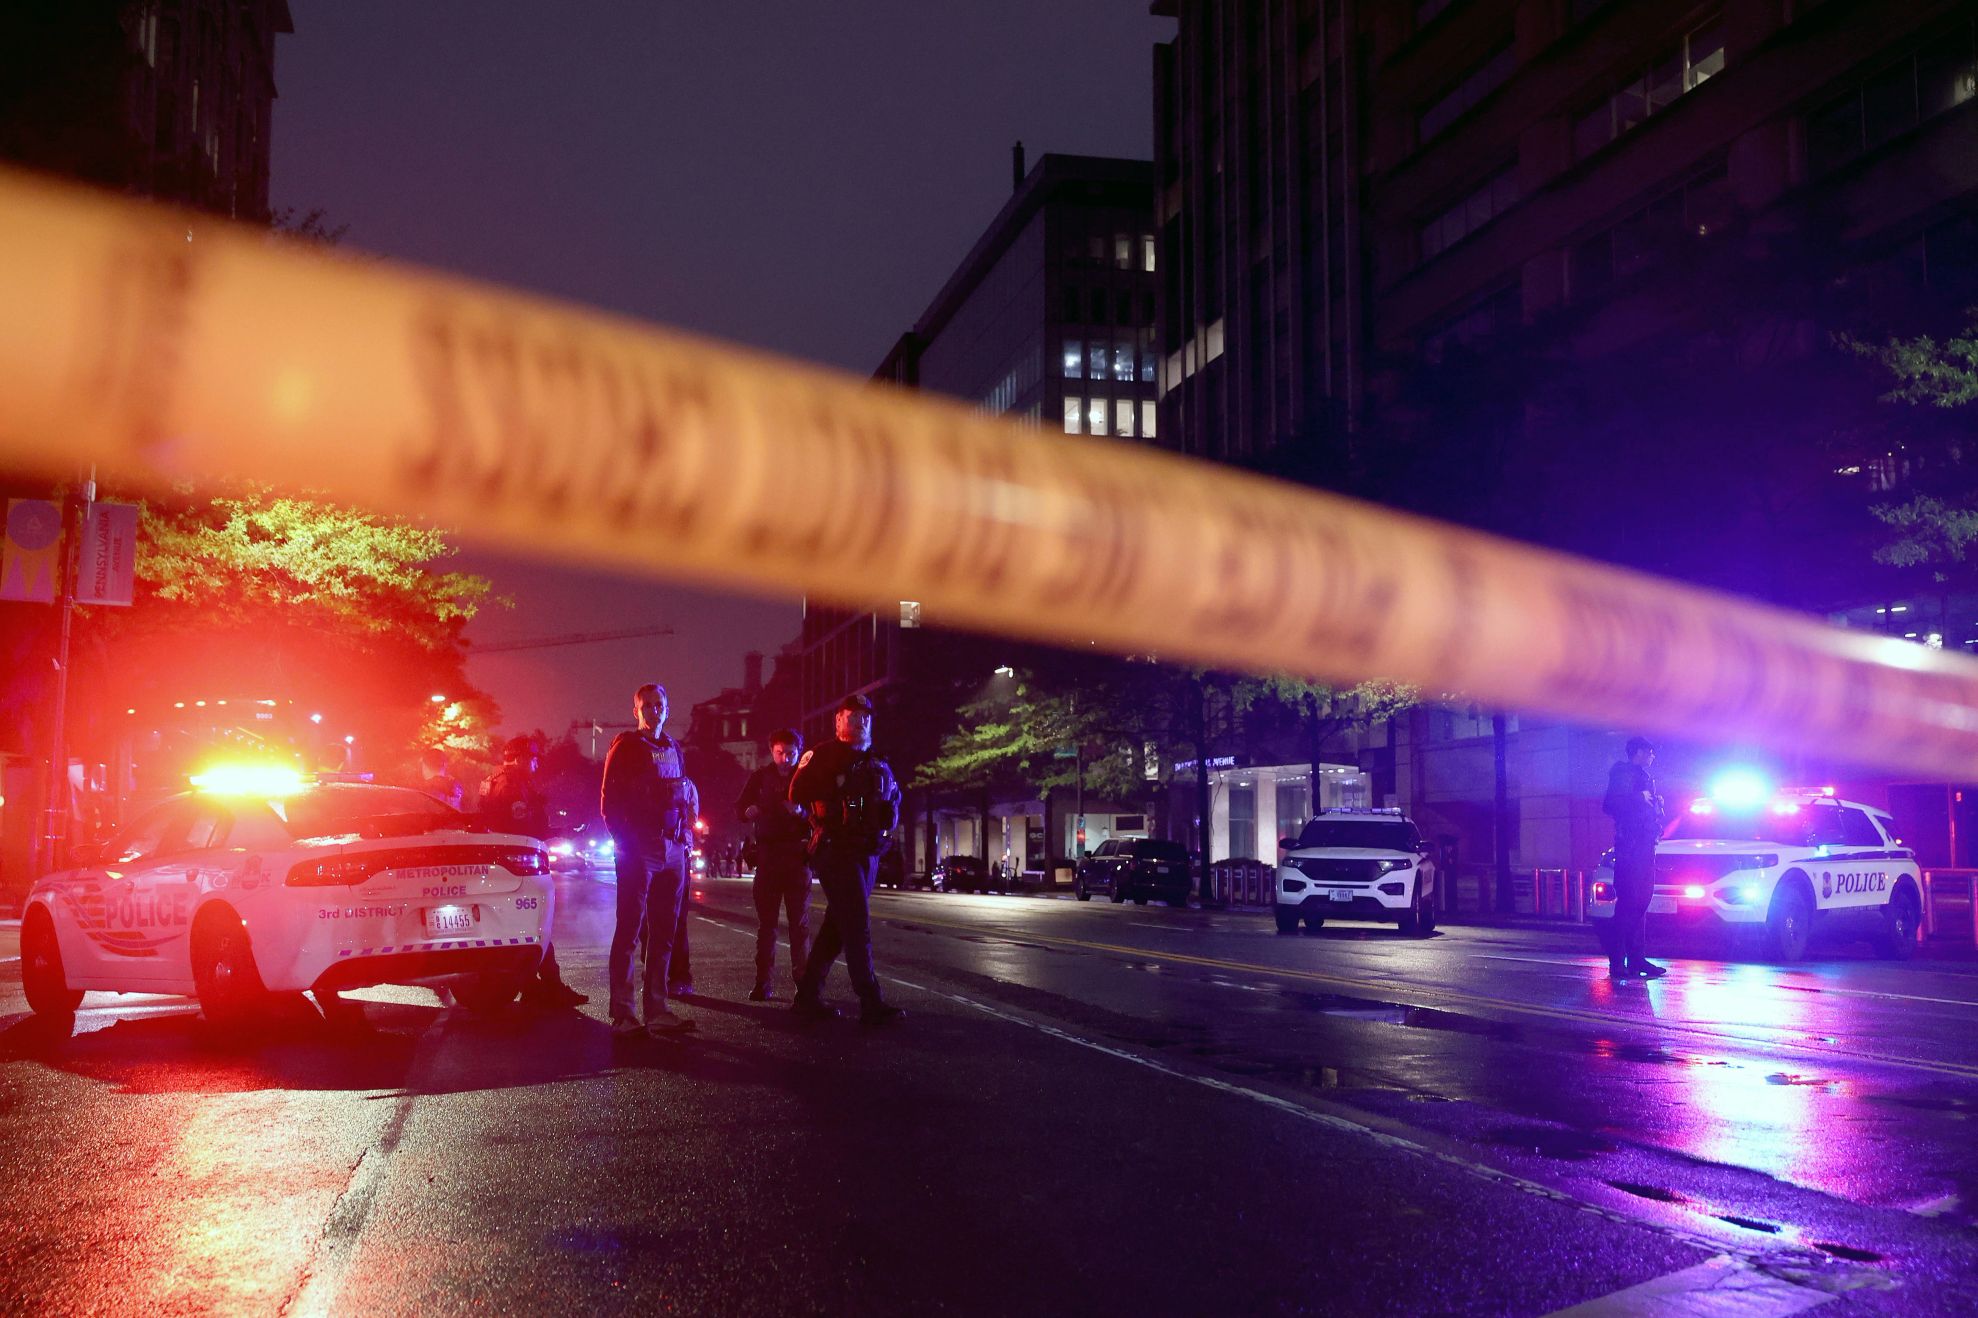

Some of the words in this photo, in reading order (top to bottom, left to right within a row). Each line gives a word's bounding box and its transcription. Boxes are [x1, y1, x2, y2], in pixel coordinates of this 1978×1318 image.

[94, 511, 110, 598] PENNSYLVANIA
[112, 536, 122, 572] AVENUE
[396, 865, 489, 880] METROPOLITAN
[1835, 872, 1886, 894] POLICE
[422, 885, 467, 897] POLICE
[105, 892, 188, 929] POLICE
[515, 898, 538, 910] 965
[318, 908, 340, 919] 3rd
[344, 907, 403, 918] DISTRICT
[443, 914, 470, 929] 14455
